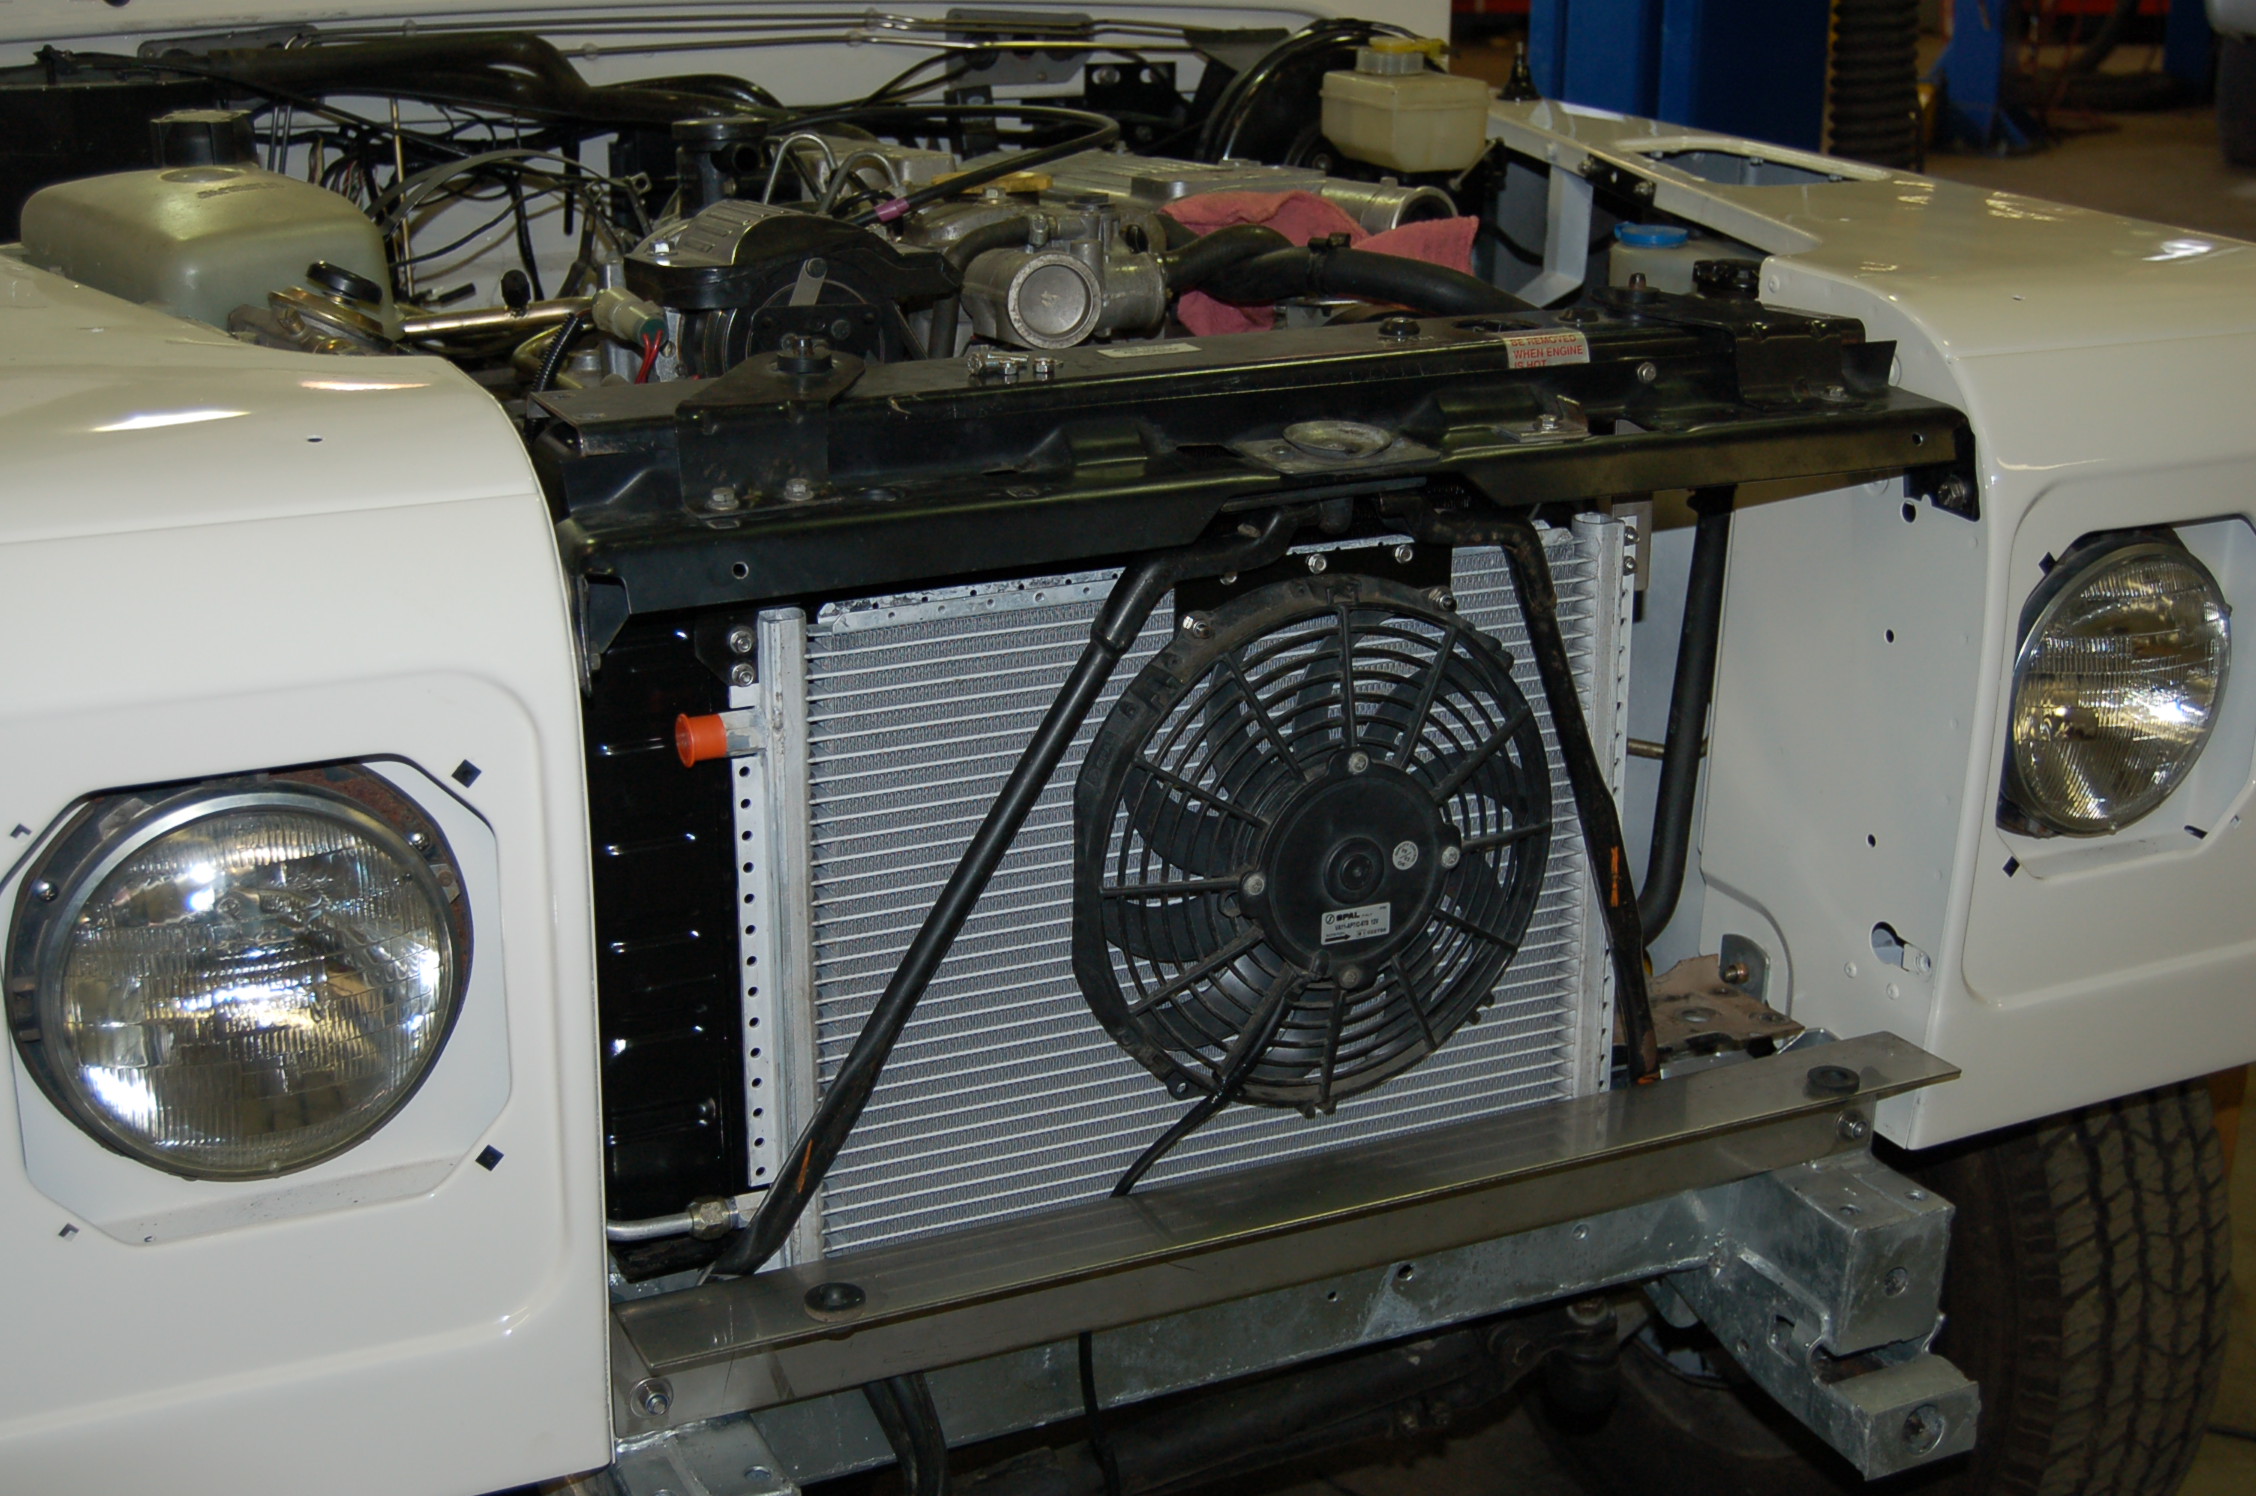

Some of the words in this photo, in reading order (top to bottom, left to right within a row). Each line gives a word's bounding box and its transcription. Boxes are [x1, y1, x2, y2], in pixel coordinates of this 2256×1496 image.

[1528, 335, 1577, 345] REMOVED
[1513, 348, 1543, 359] WHEN
[1546, 345, 1583, 357] ENGINE
[1526, 360, 1547, 368] HOT
